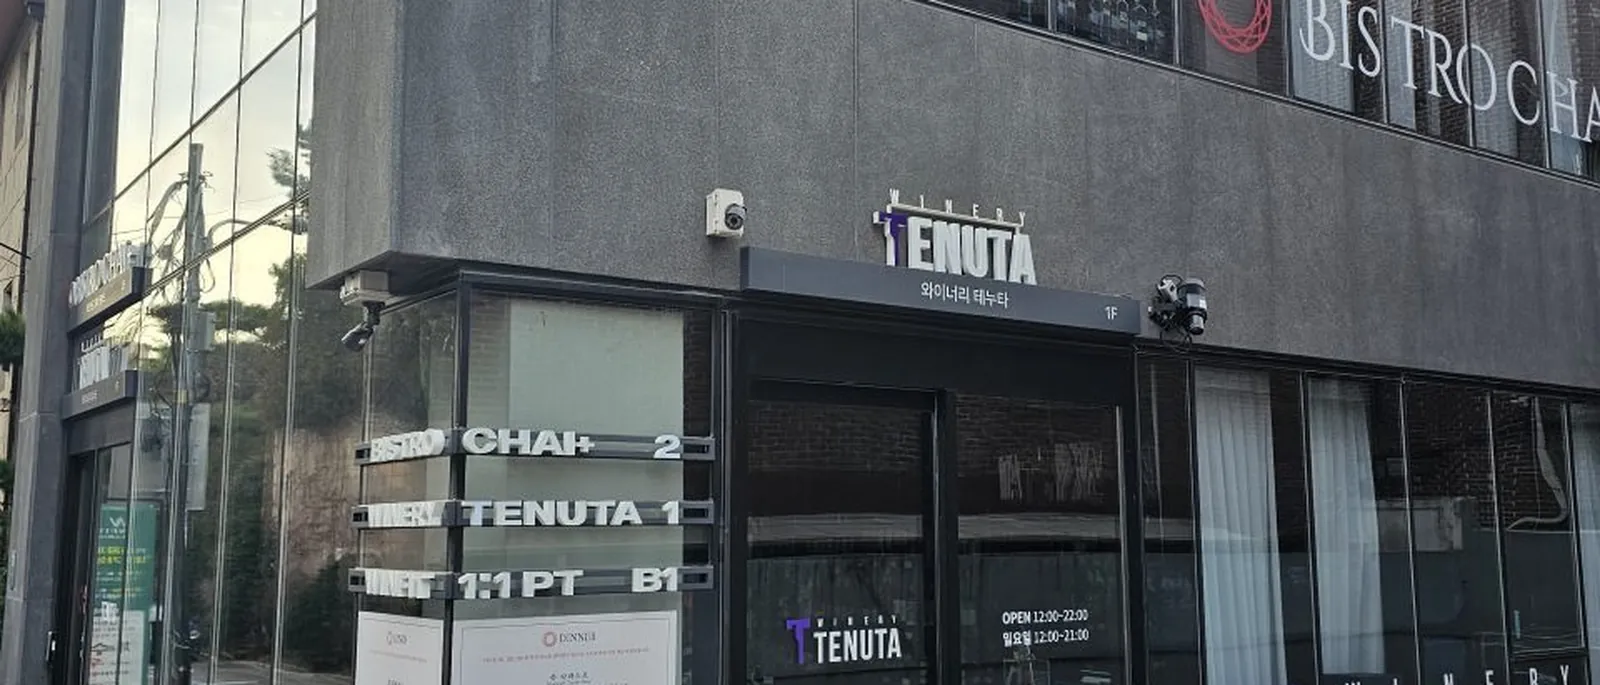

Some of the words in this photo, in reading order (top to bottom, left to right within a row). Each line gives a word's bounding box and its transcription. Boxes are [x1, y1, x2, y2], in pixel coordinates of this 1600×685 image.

[1300, 0, 1496, 111] BISTRO
[889, 188, 1026, 227] WINERY
[873, 210, 1038, 286] TENUTA
[921, 281, 970, 304] 와이너리
[973, 289, 1009, 309] 테누타
[1104, 306, 1119, 320] 1F
[370, 428, 445, 462] BISTRO
[462, 427, 595, 456] CHAI+
[653, 434, 681, 459] 2
[461, 500, 643, 527] TENUTA
[662, 500, 680, 525] 1
[458, 572, 511, 600] 1:1
[522, 570, 584, 597] PT
[631, 567, 679, 593] B1
[1002, 611, 1031, 625] OPEN
[813, 627, 902, 664] TENUTA
[1002, 630, 1032, 648] 일요일
